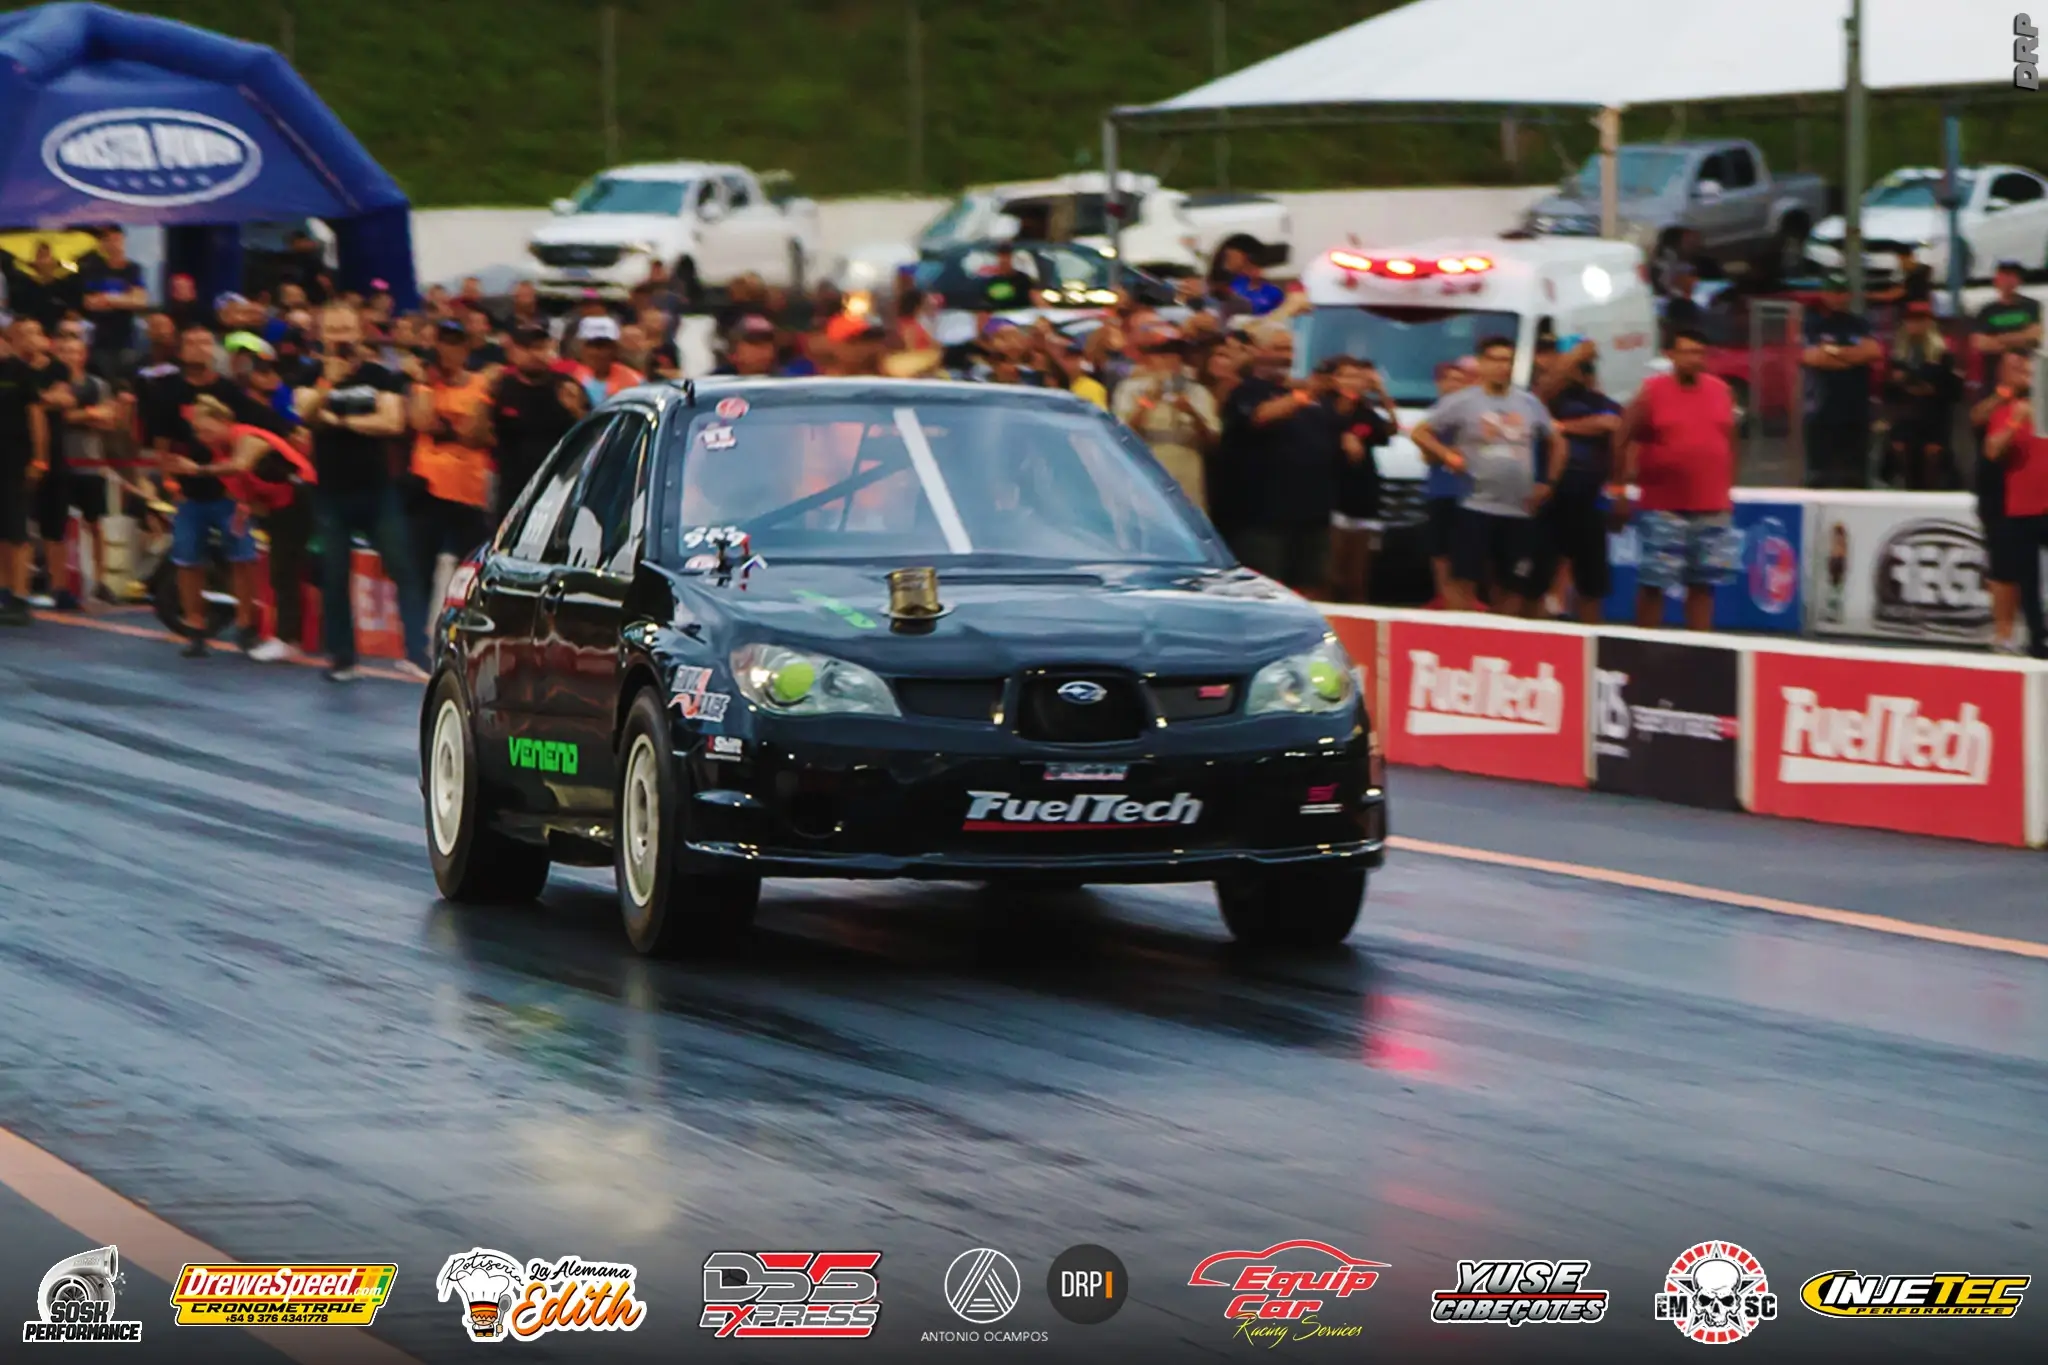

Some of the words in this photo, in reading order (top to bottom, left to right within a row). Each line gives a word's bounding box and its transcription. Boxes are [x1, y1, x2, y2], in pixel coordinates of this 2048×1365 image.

[1408, 649, 1564, 730] FuelTech
[1779, 685, 1993, 780] FuelTech
[966, 790, 1203, 824] FuelTech
